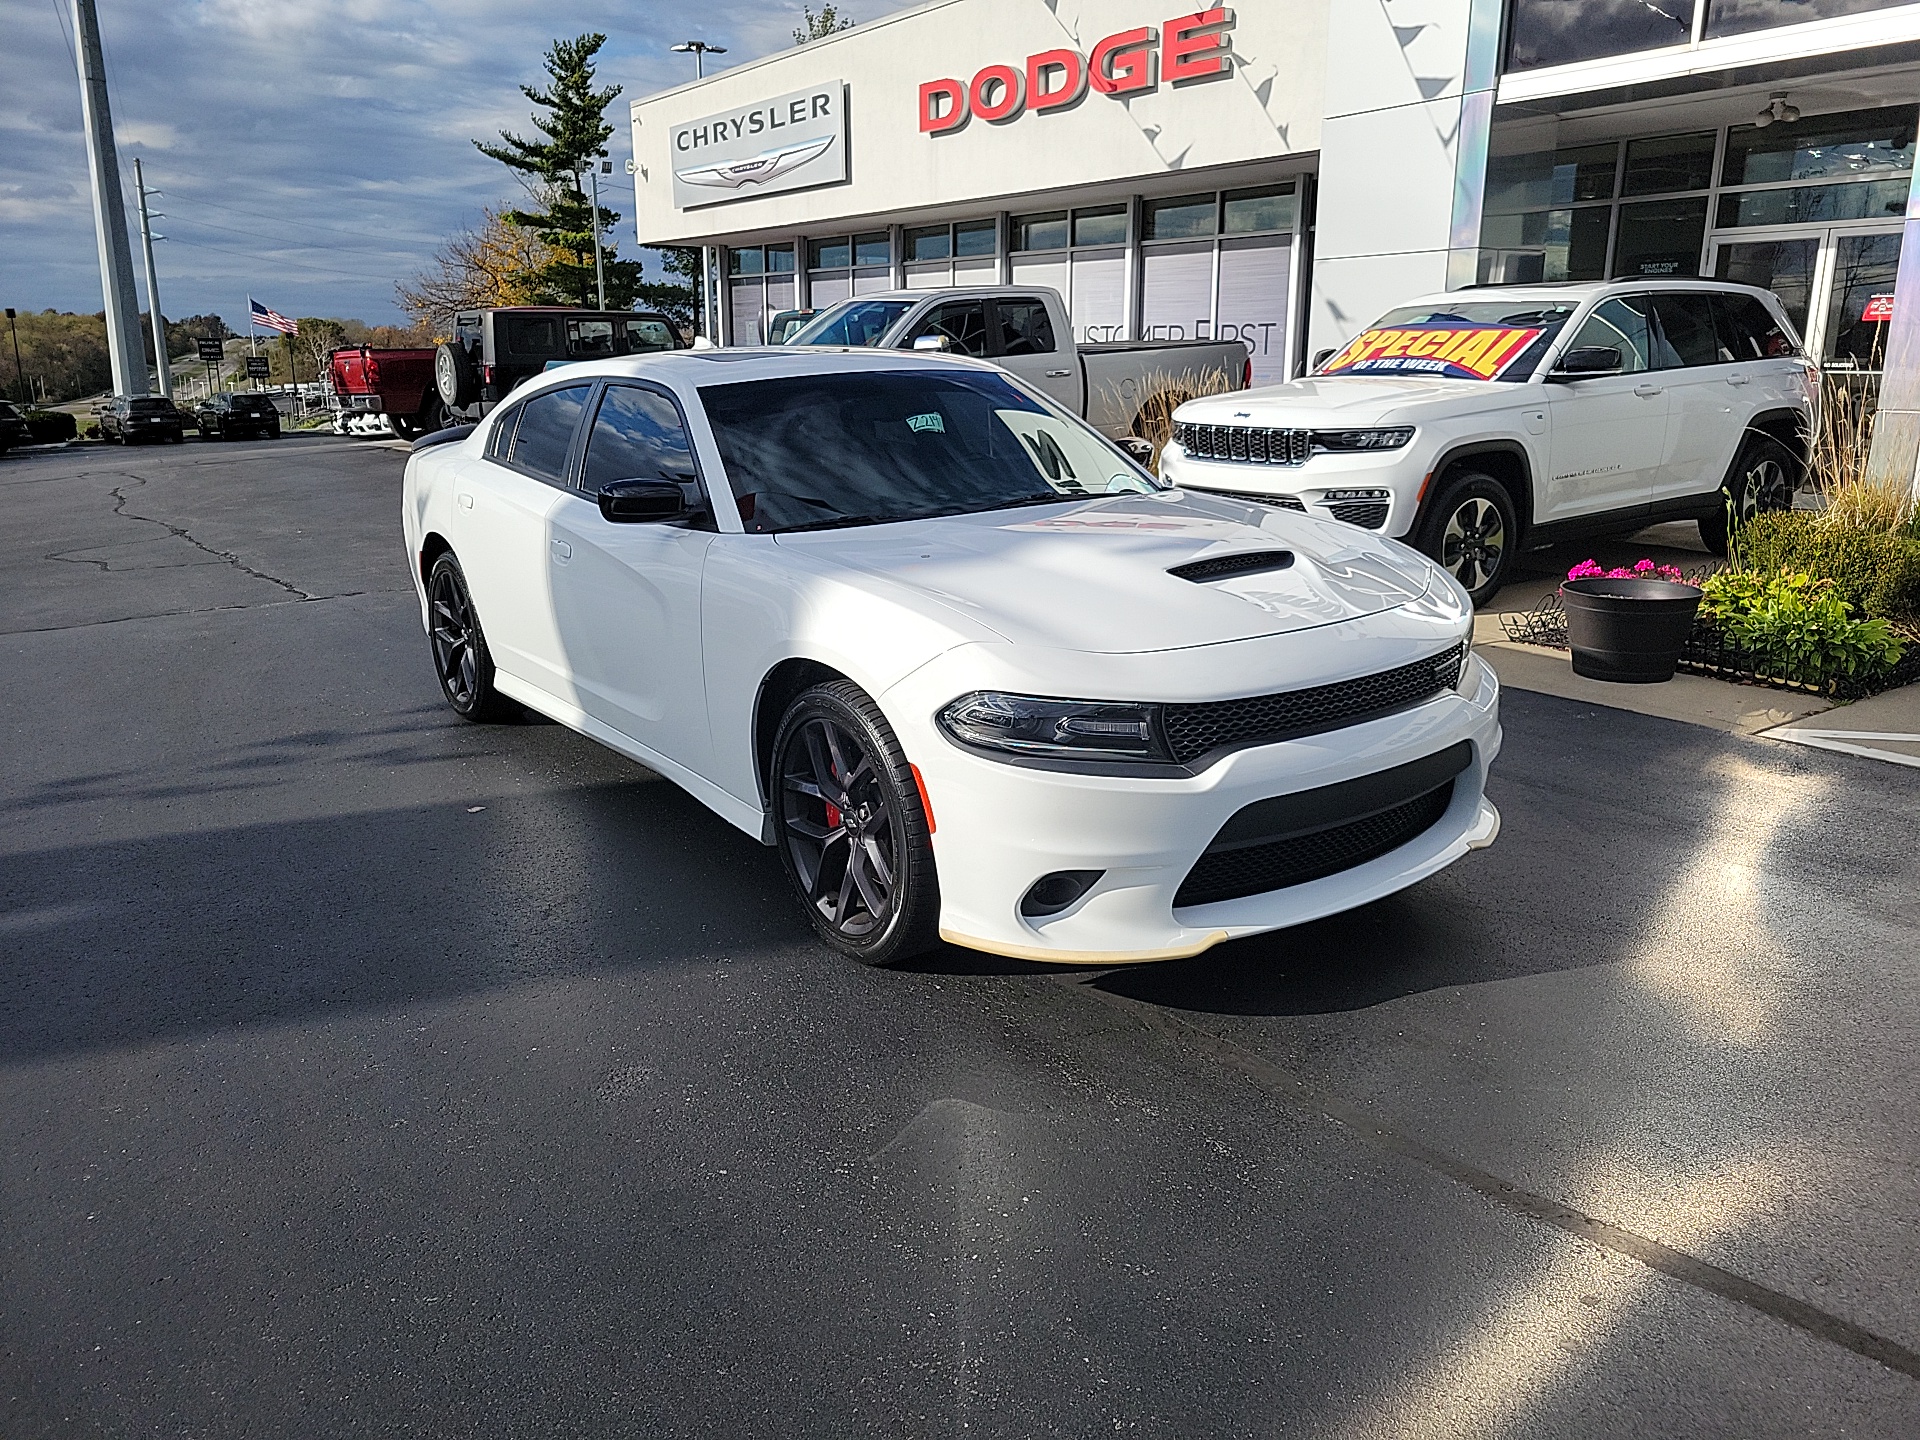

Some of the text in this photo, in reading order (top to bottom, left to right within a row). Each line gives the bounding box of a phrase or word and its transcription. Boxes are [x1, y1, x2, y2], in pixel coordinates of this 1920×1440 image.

[919, 7, 1232, 136] DODGE
[676, 93, 832, 152] CHRYSLER
[1195, 319, 1277, 355] FRST
[1328, 330, 1528, 377] SPECIAL
[1353, 359, 1450, 372] OF THE WEEK
